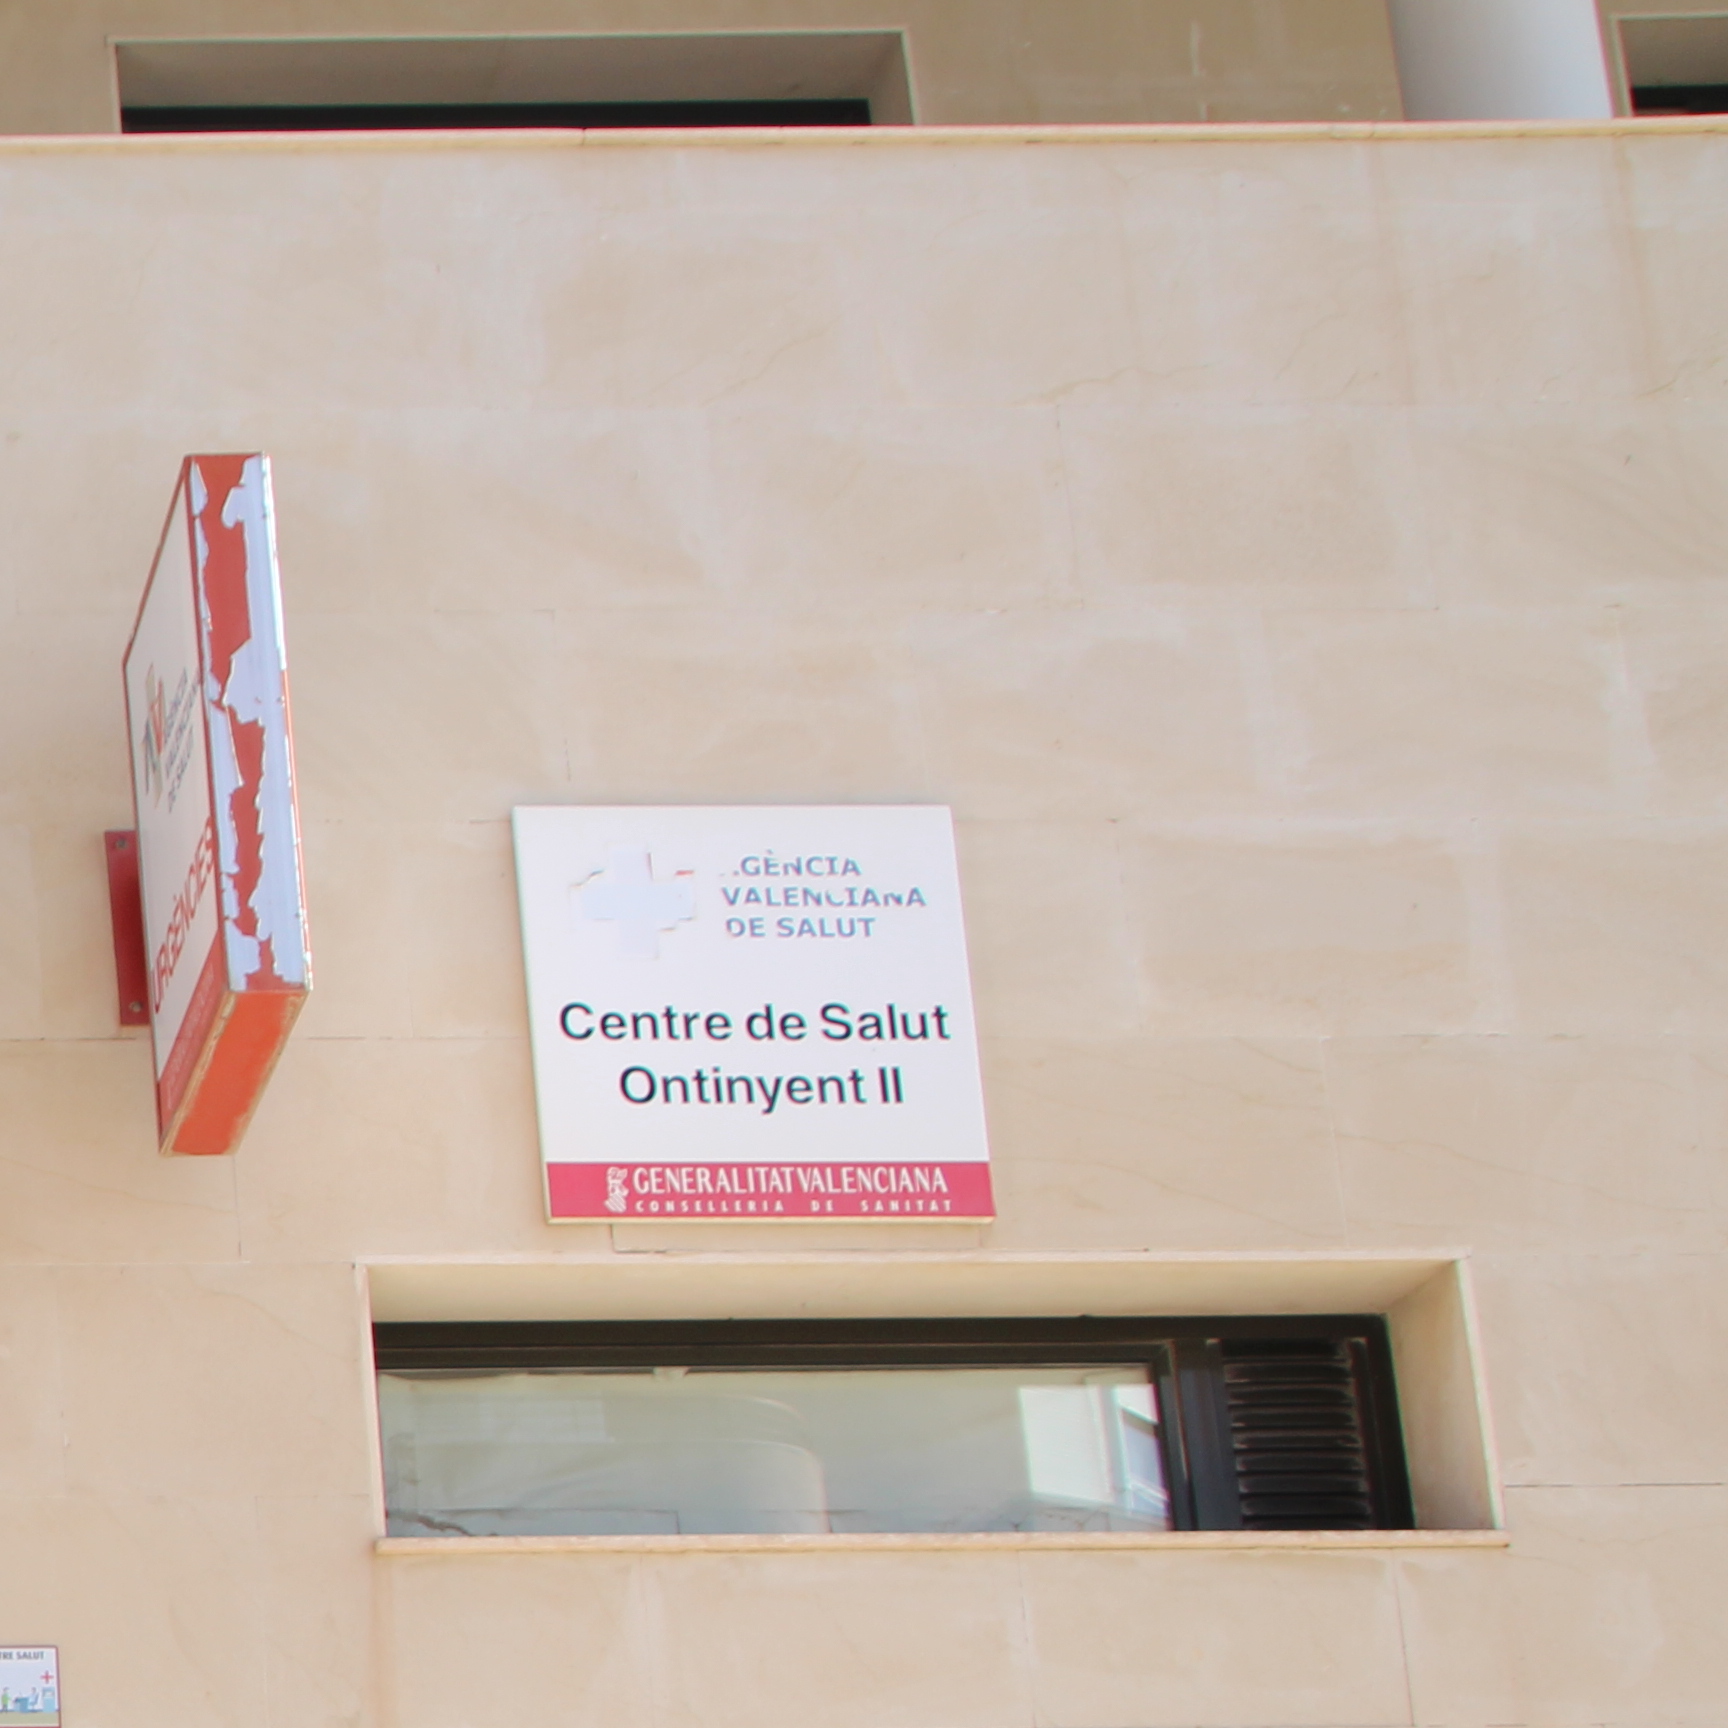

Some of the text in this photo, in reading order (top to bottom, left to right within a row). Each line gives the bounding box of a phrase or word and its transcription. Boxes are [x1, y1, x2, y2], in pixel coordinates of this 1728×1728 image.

[720, 849, 862, 877] GÈNCIA
[725, 917, 876, 938] DE SALUT
[559, 1002, 952, 1041] Centre de Salut
[619, 1065, 905, 1115] Ontinyent II
[632, 1166, 949, 1195] GENERALITAT VALENCIANA
[635, 1200, 952, 1214] CONSELLERIA DE SANITAT
[16, 1651, 44, 1660] SALUT
